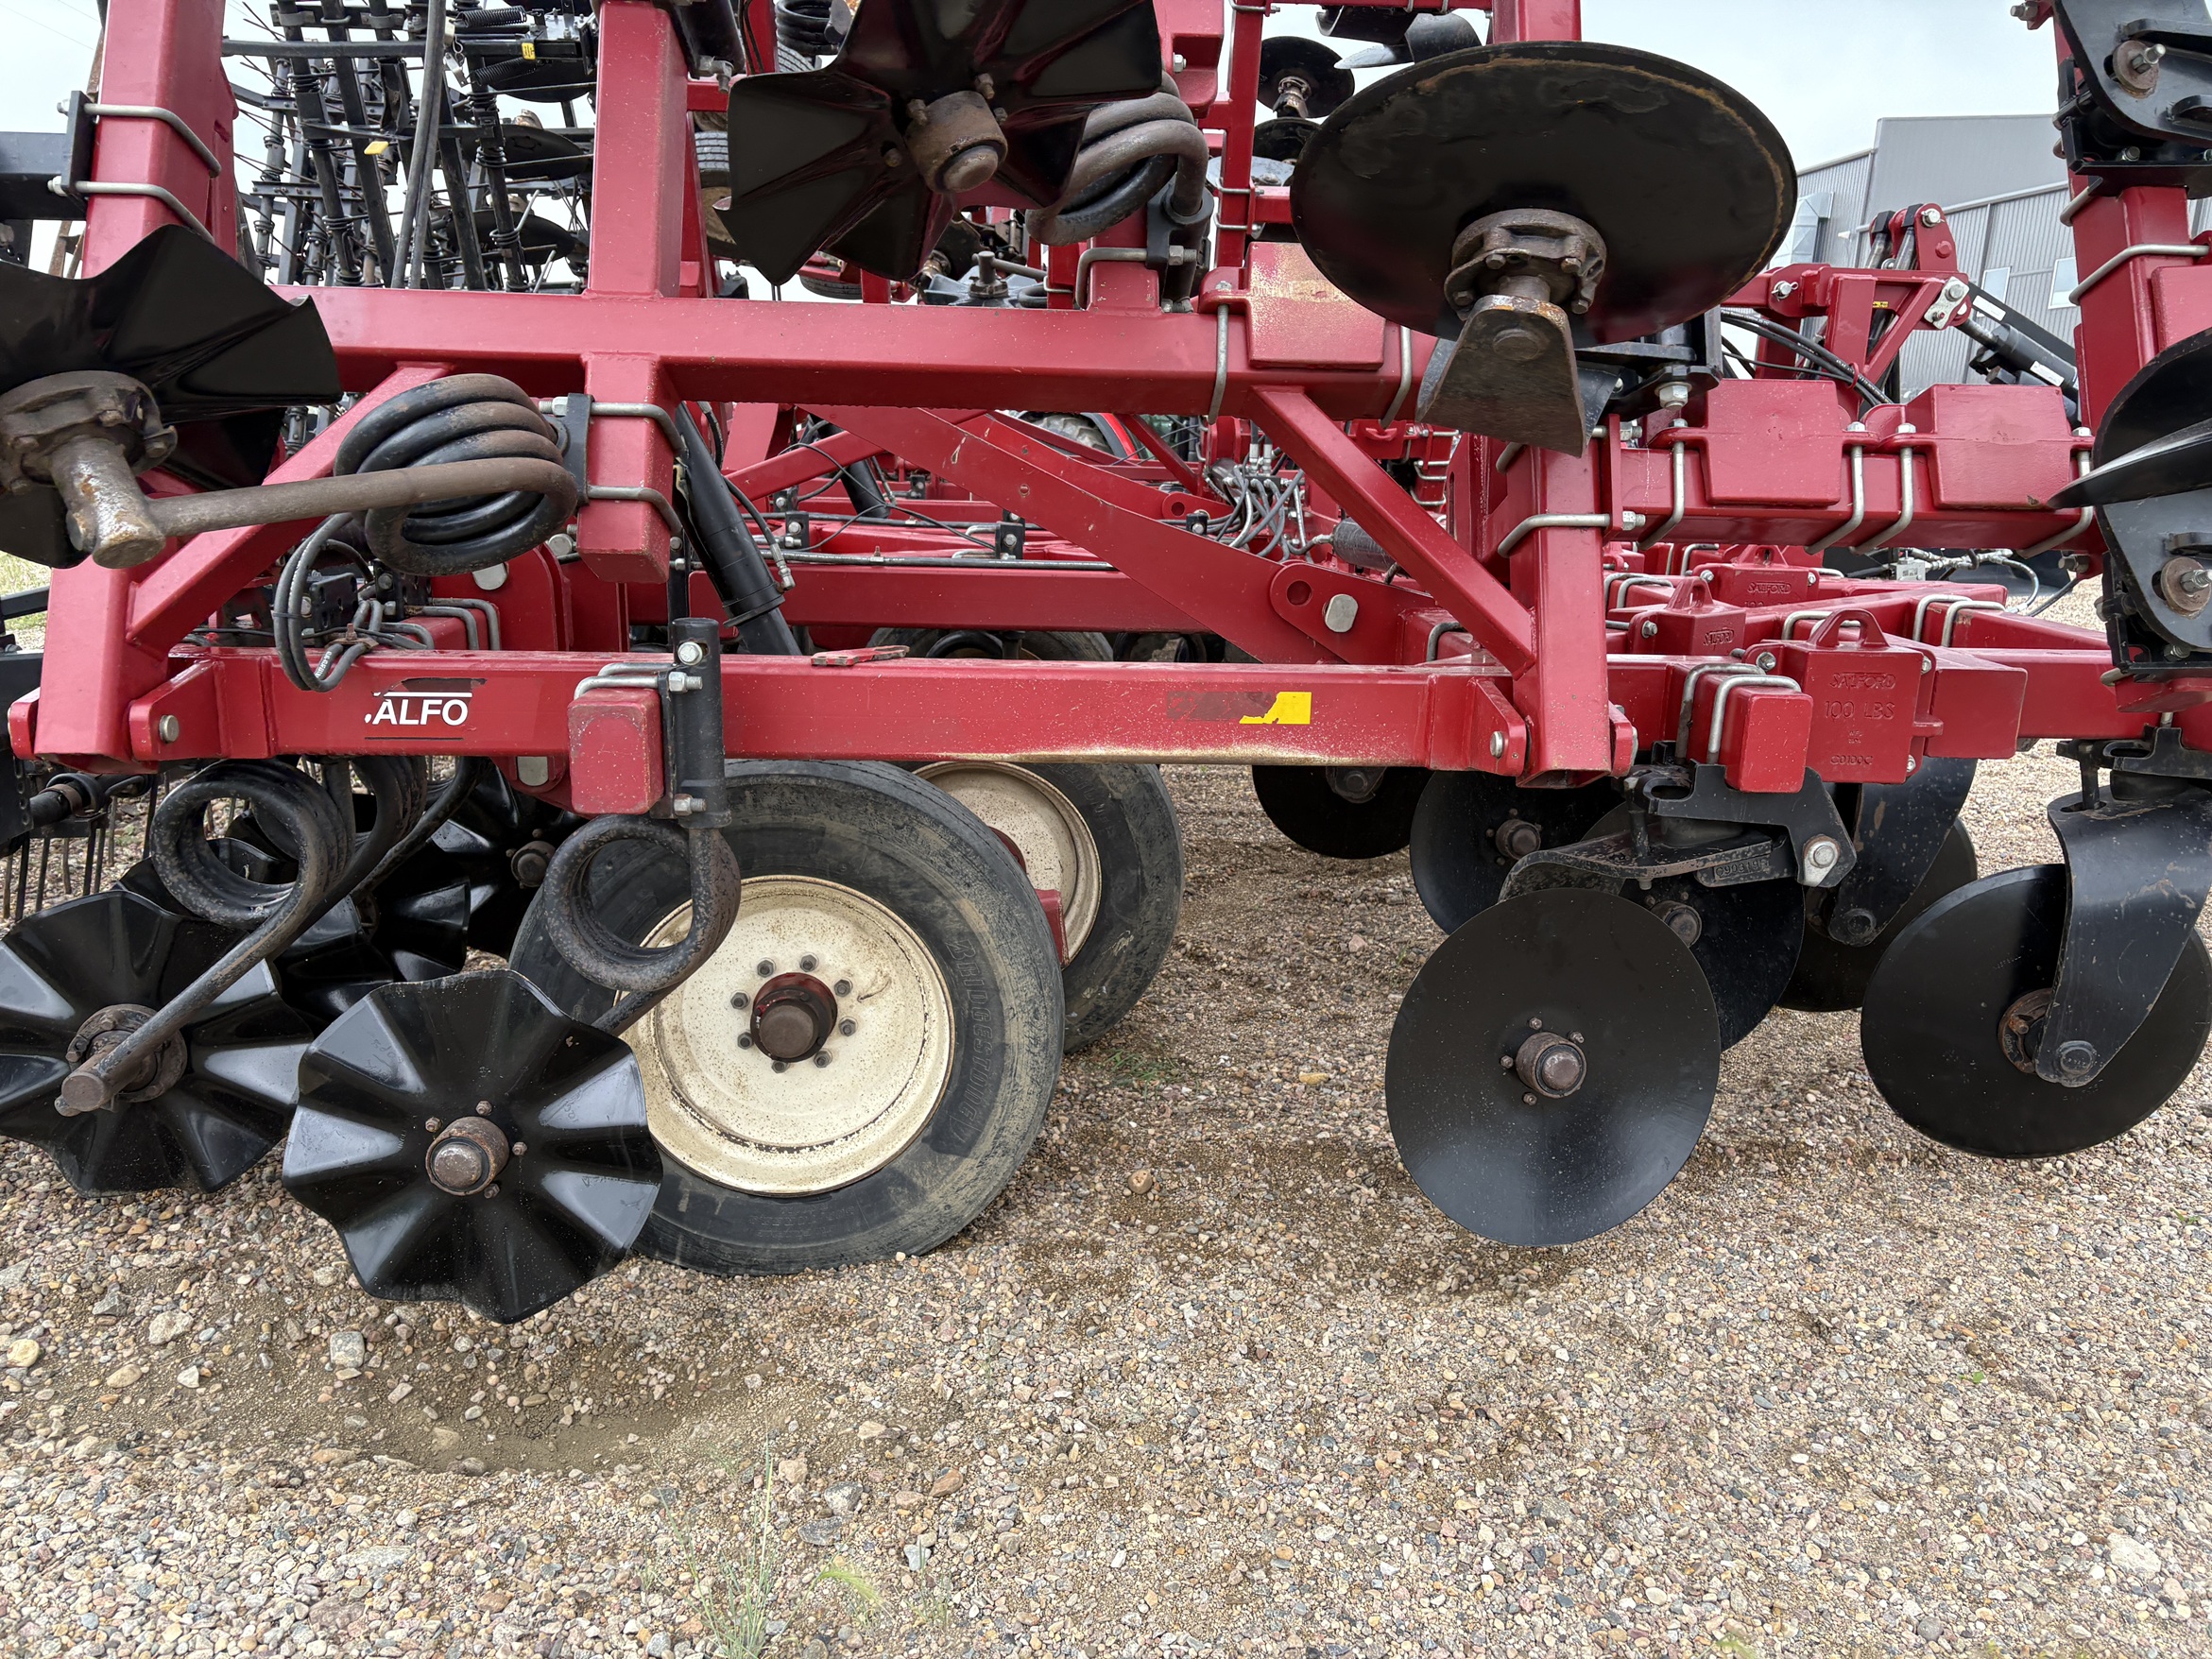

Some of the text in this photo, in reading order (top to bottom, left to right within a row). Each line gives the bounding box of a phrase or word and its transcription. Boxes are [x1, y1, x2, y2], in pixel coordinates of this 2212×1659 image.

[1746, 581, 1792, 594] SALFORD
[1829, 672, 1896, 689] SALFORD
[365, 697, 469, 727] ALFO
[1825, 700, 1895, 720] 100 LBS
[945, 938, 993, 1122] BRIDGESTONE
